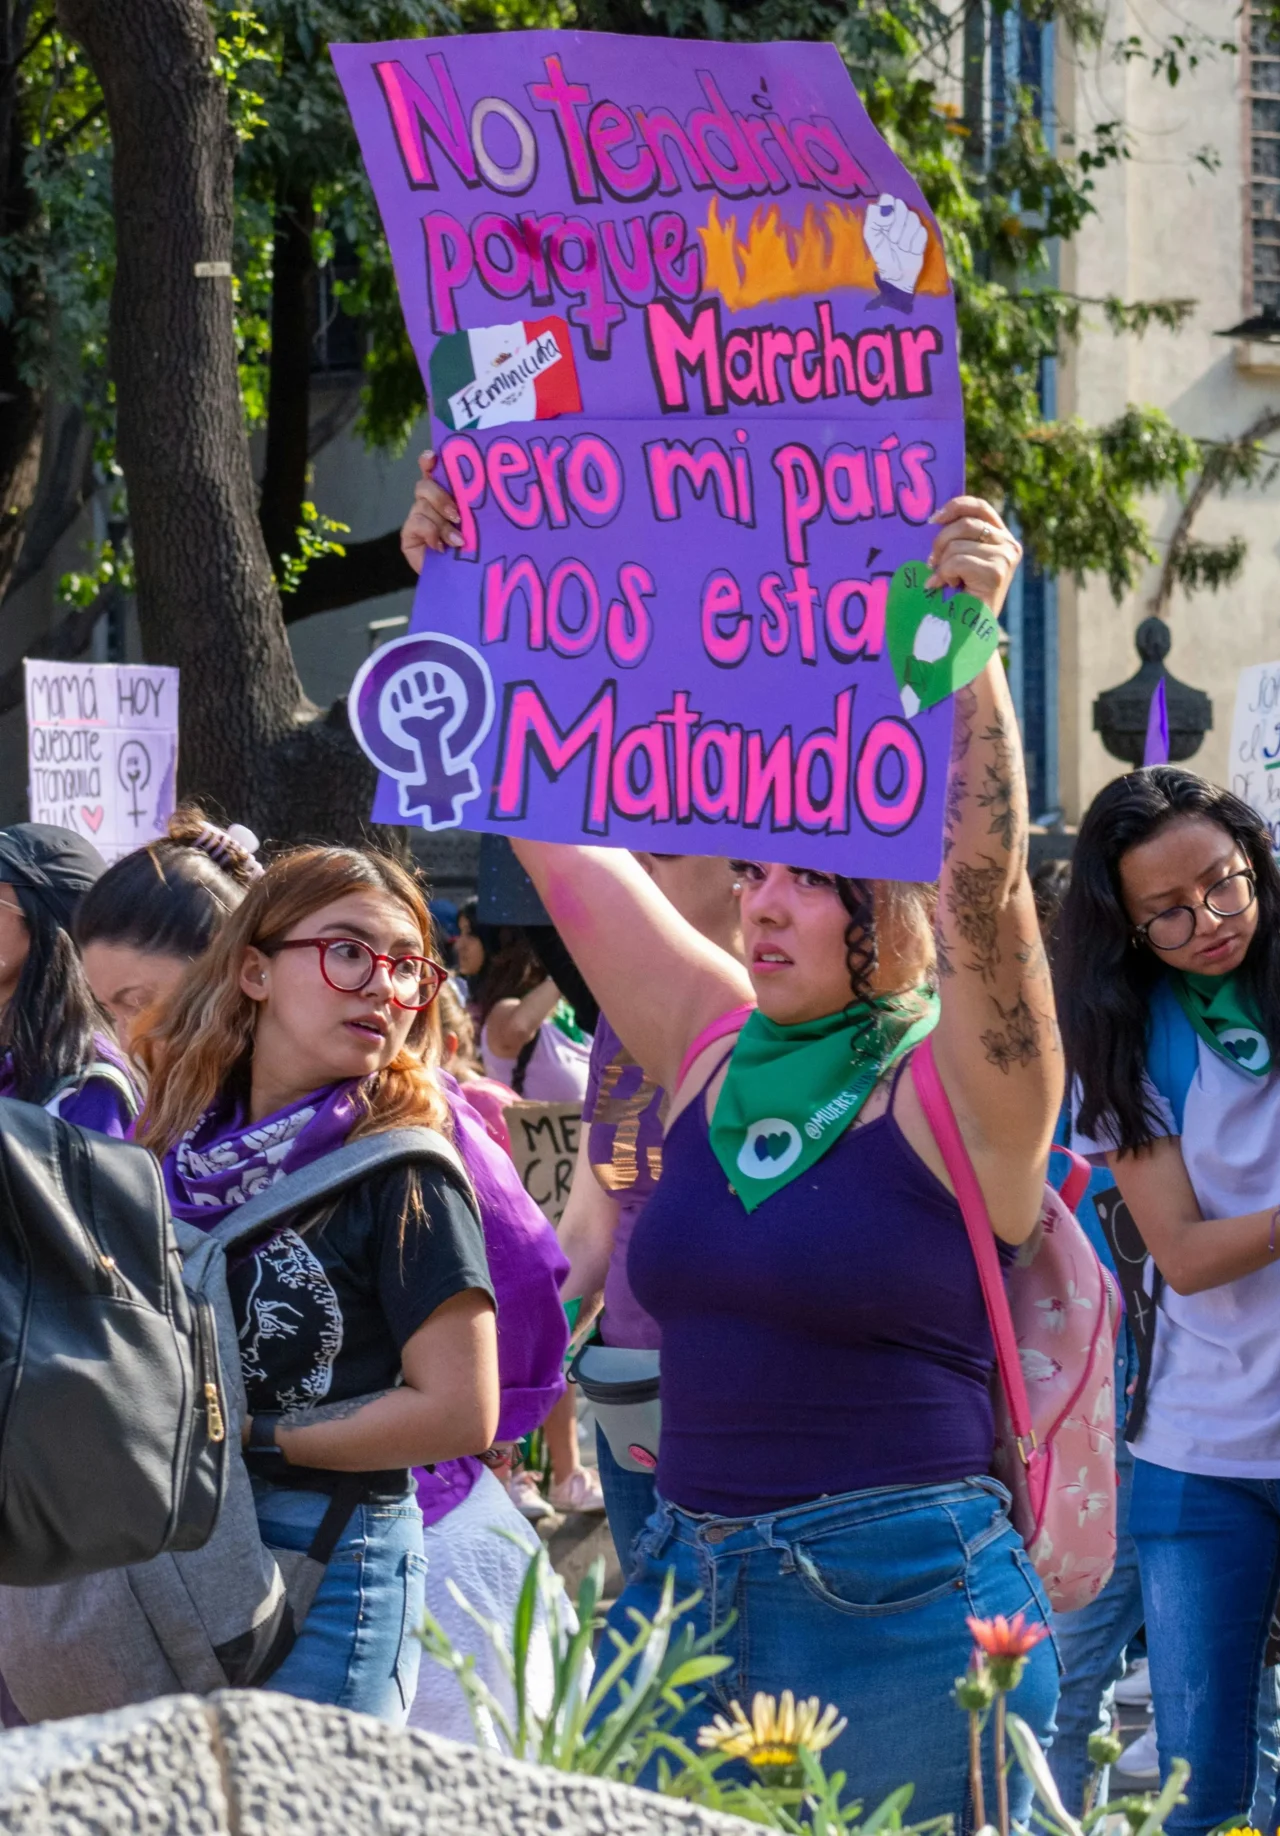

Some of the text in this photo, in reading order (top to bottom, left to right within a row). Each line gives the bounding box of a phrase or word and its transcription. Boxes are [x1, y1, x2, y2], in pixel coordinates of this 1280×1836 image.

[372, 53, 880, 200] No tendría
[423, 209, 700, 360] porque
[644, 299, 942, 415] Marchar
[438, 427, 937, 567] pero mi país
[481, 546, 901, 668] nos está
[118, 677, 165, 717] HOY
[487, 679, 926, 836] Matando
[520, 1114, 581, 1155] ME
